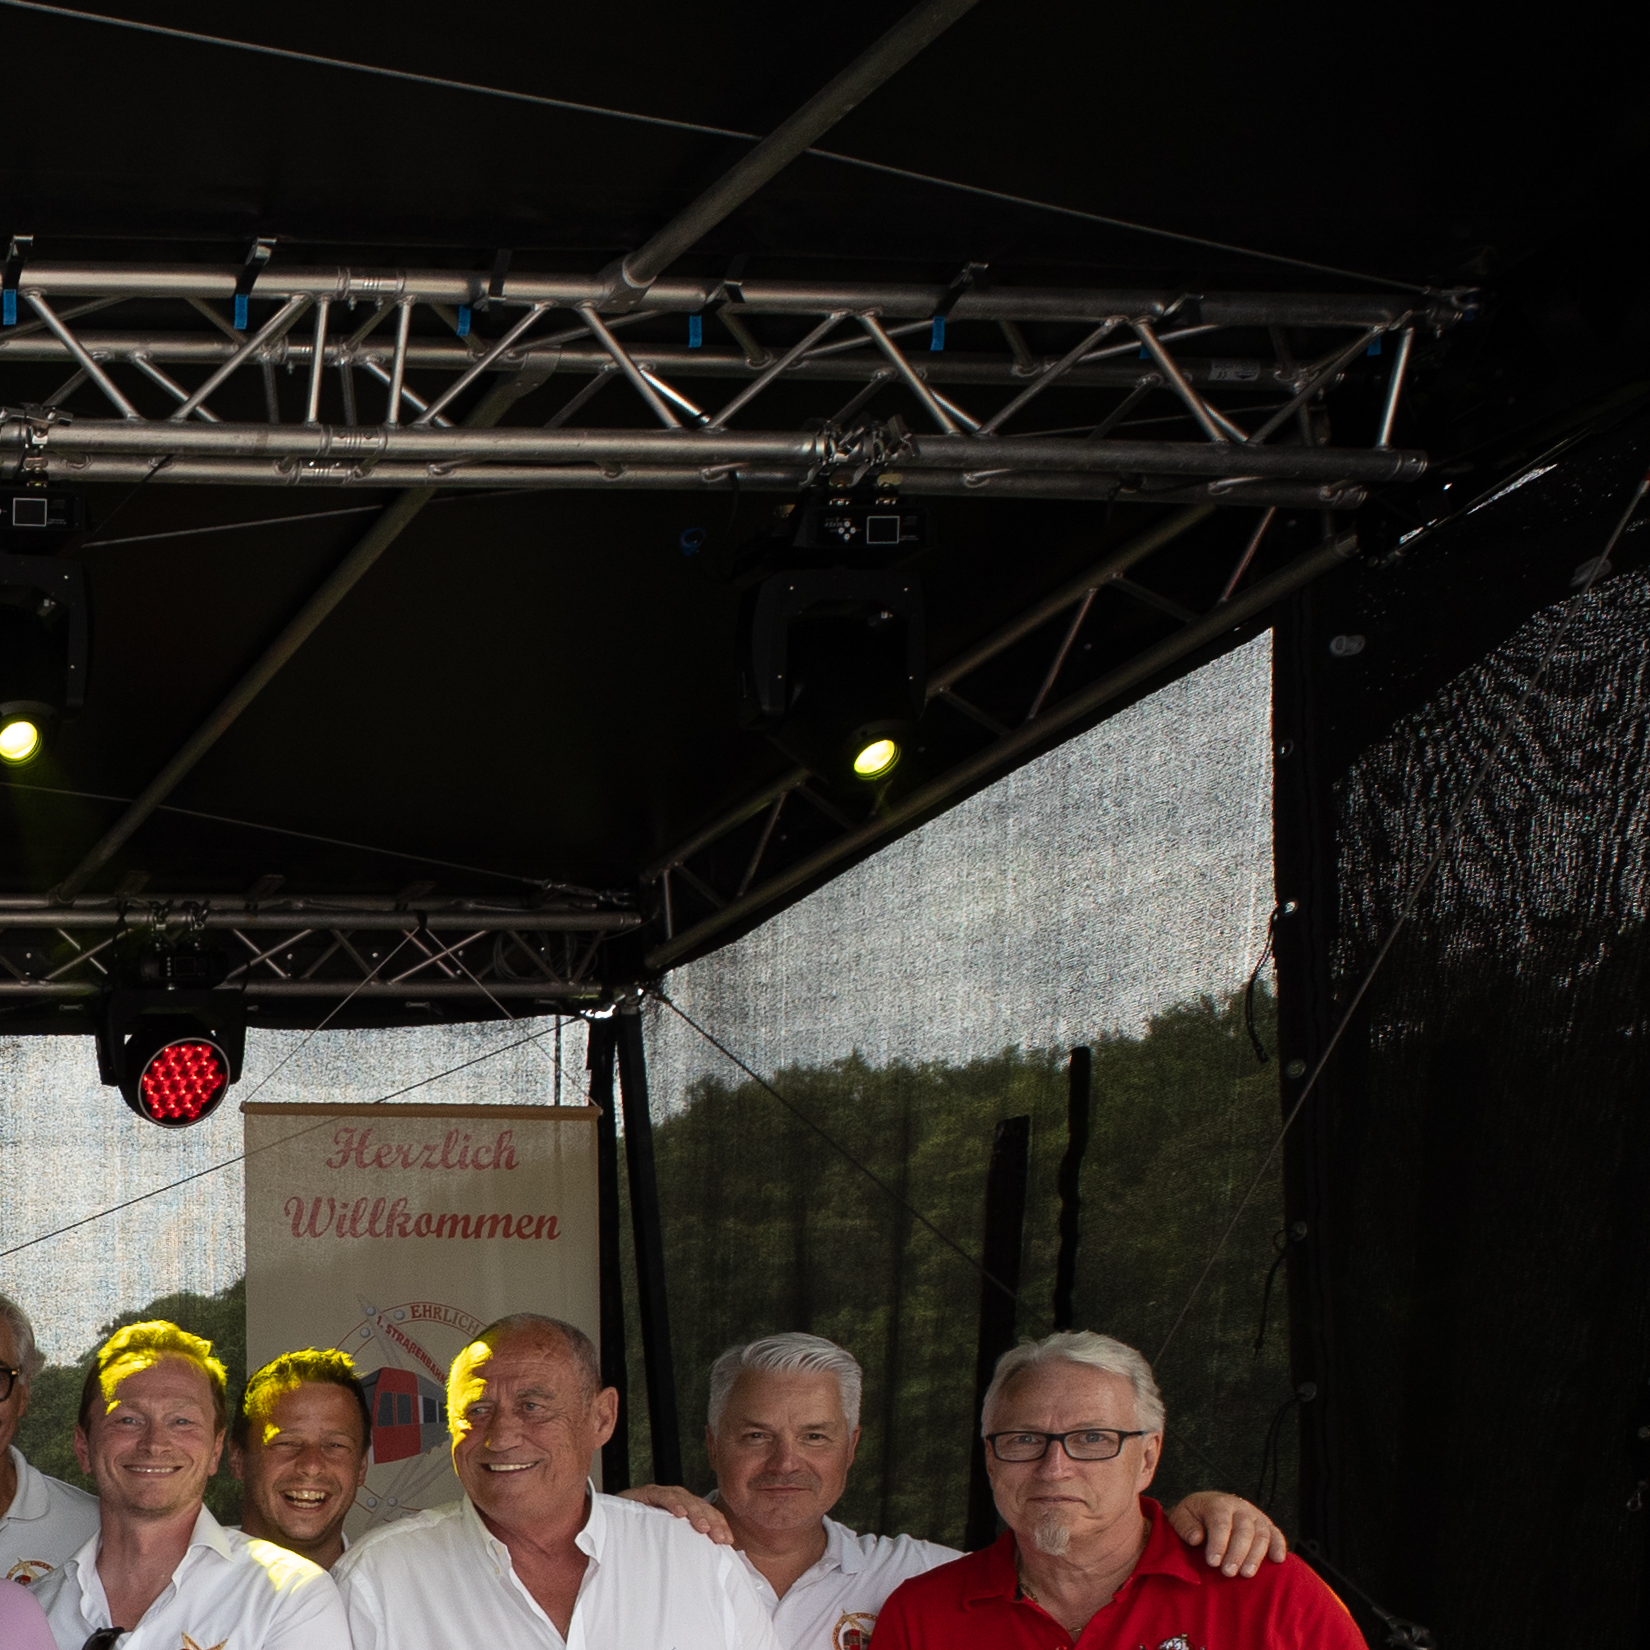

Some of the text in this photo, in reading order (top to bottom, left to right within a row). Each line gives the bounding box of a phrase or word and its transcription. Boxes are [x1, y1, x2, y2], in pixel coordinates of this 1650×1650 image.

[325, 1126, 520, 1171] Herzlich
[283, 1195, 562, 1241] Willkommen
[410, 1304, 481, 1337] EHRLICH
